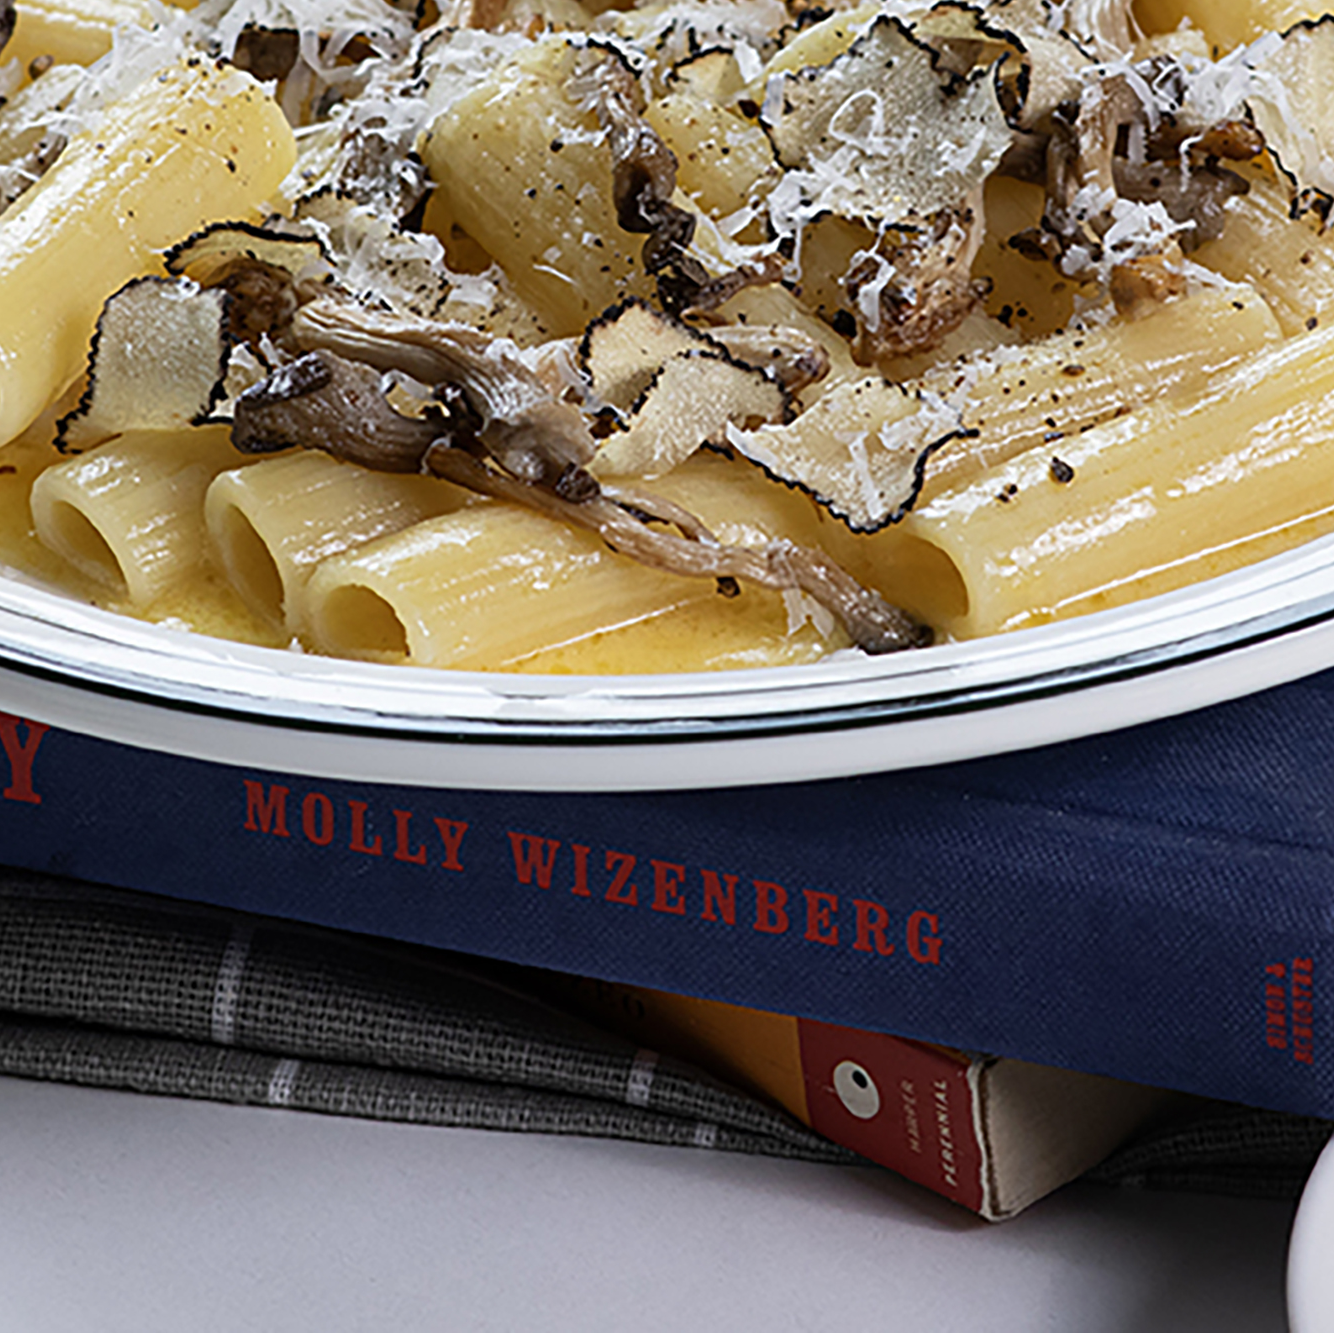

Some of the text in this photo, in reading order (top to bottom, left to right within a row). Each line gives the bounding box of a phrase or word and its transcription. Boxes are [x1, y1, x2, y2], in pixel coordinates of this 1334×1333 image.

[243, 779, 943, 965] MOLLY WIZENBERG
[934, 1081, 958, 1188] PERENNIAL
